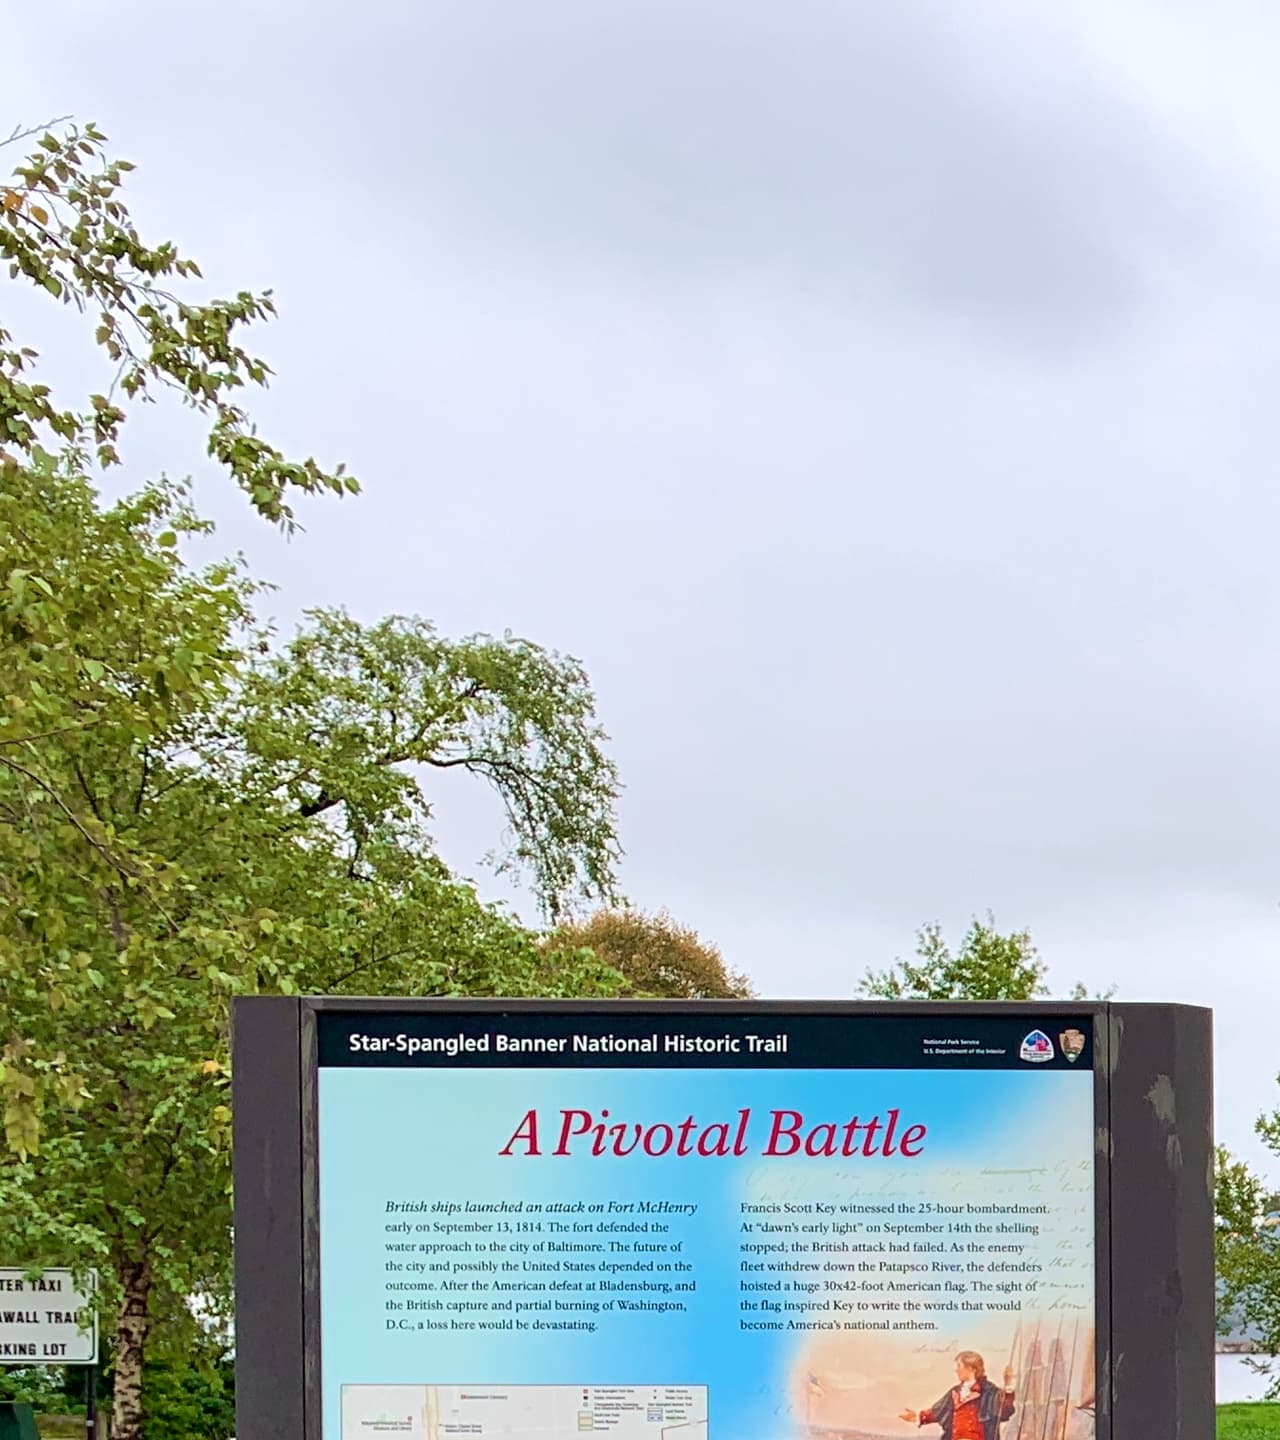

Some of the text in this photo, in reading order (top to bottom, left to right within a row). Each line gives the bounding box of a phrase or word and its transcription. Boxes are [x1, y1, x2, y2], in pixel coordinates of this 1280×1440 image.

[349, 1033, 788, 1057] Star-Spangled Banner National Historic Trail
[498, 1109, 926, 1157] A Pivotal Battle
[385, 1200, 698, 1217] British ships launched an attack on Fort McHenry
[740, 1202, 1050, 1218] Francis Scott Key witnessed the 25-hour bombardment.
[384, 1220, 670, 1236] early on September 13, 1814. The fort defended the
[739, 1221, 754, 1233] At
[801, 1221, 830, 1236] early
[865, 1224, 881, 1233] on
[882, 1221, 945, 1237] September
[947, 1222, 973, 1234] 14th
[974, 1221, 993, 1234] the
[995, 1221, 1040, 1237] shelling
[384, 1240, 683, 1256] water approach to the city of Baltimore. The future of
[739, 1240, 1025, 1256] stopped; the British attack had failed. As the enemy
[384, 1259, 693, 1276] the city and possibly the United States depended on the
[31, 1279, 61, 1292] TAXI
[46, 1311, 84, 1324] TRAI
[43, 1343, 67, 1356] LOT
